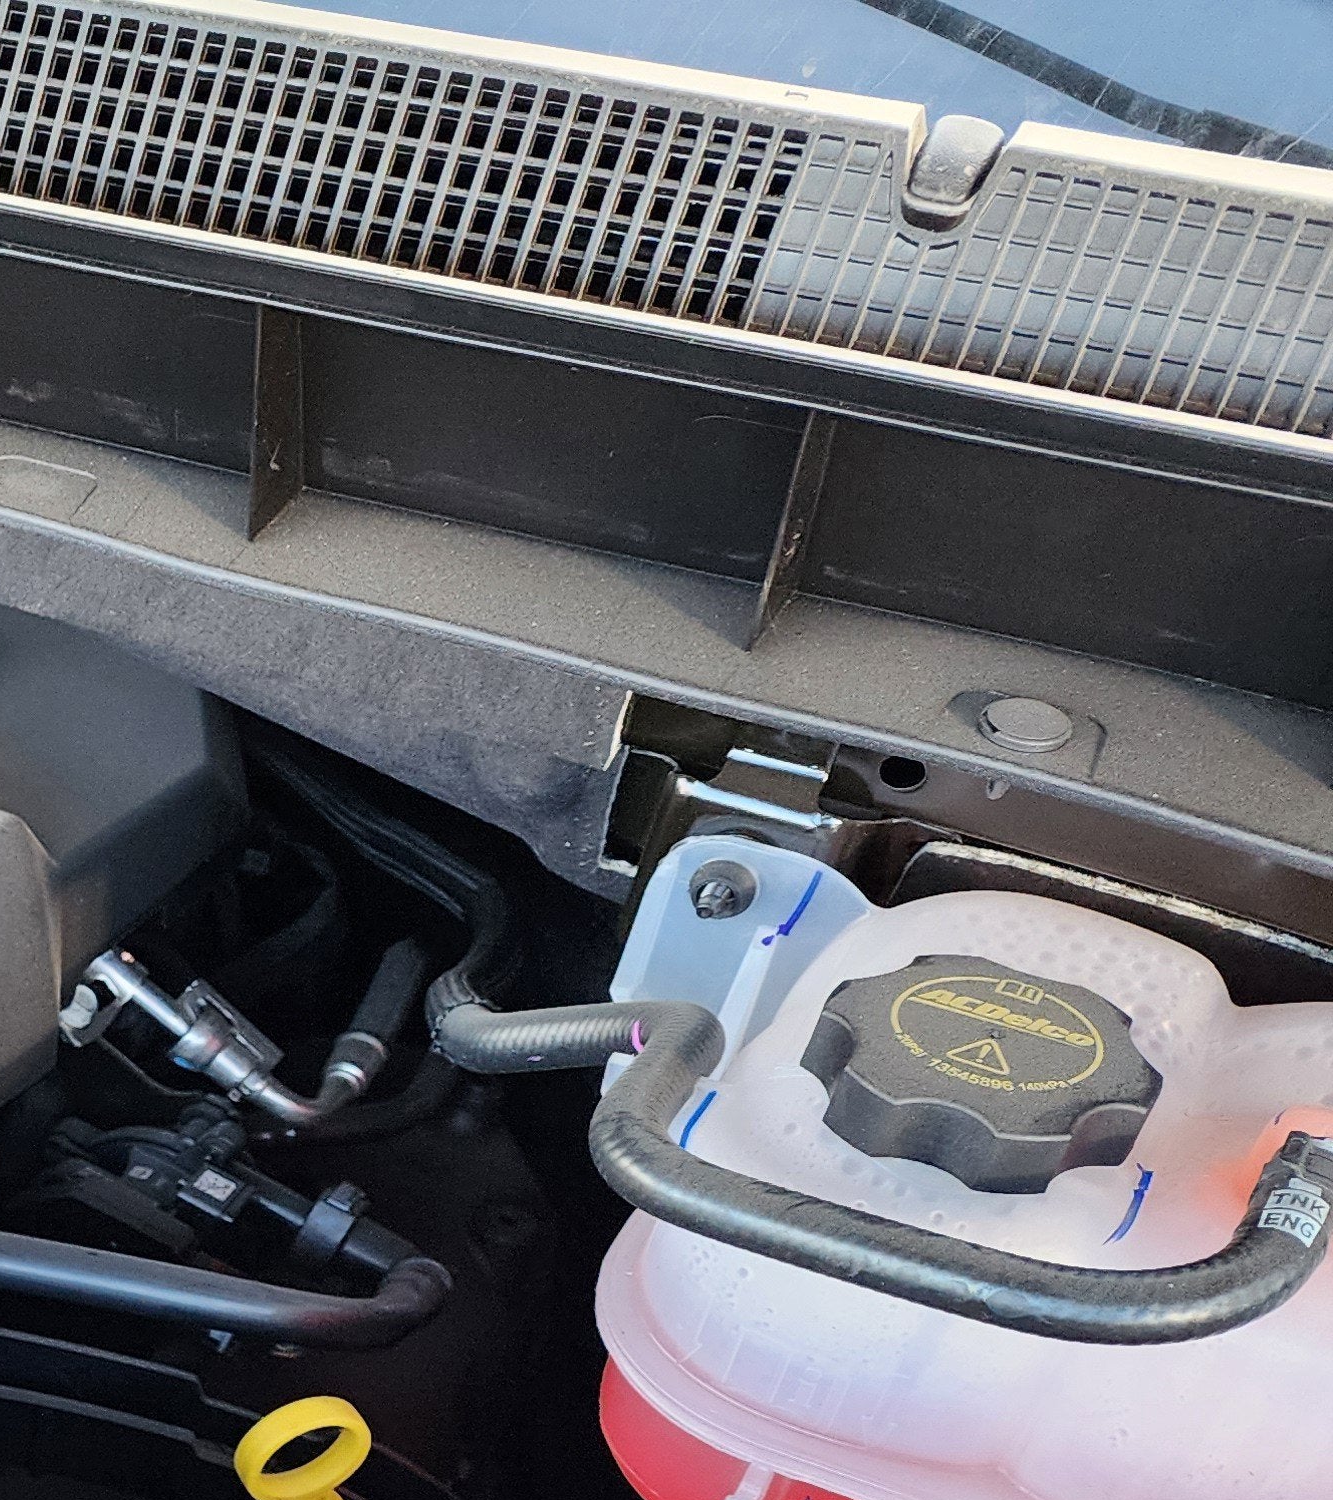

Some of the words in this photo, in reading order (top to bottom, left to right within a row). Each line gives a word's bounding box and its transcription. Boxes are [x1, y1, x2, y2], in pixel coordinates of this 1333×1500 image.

[917, 989, 1095, 1047] ACDelco
[1272, 1191, 1325, 1223] TNK
[1263, 1212, 1316, 1239] ENG
